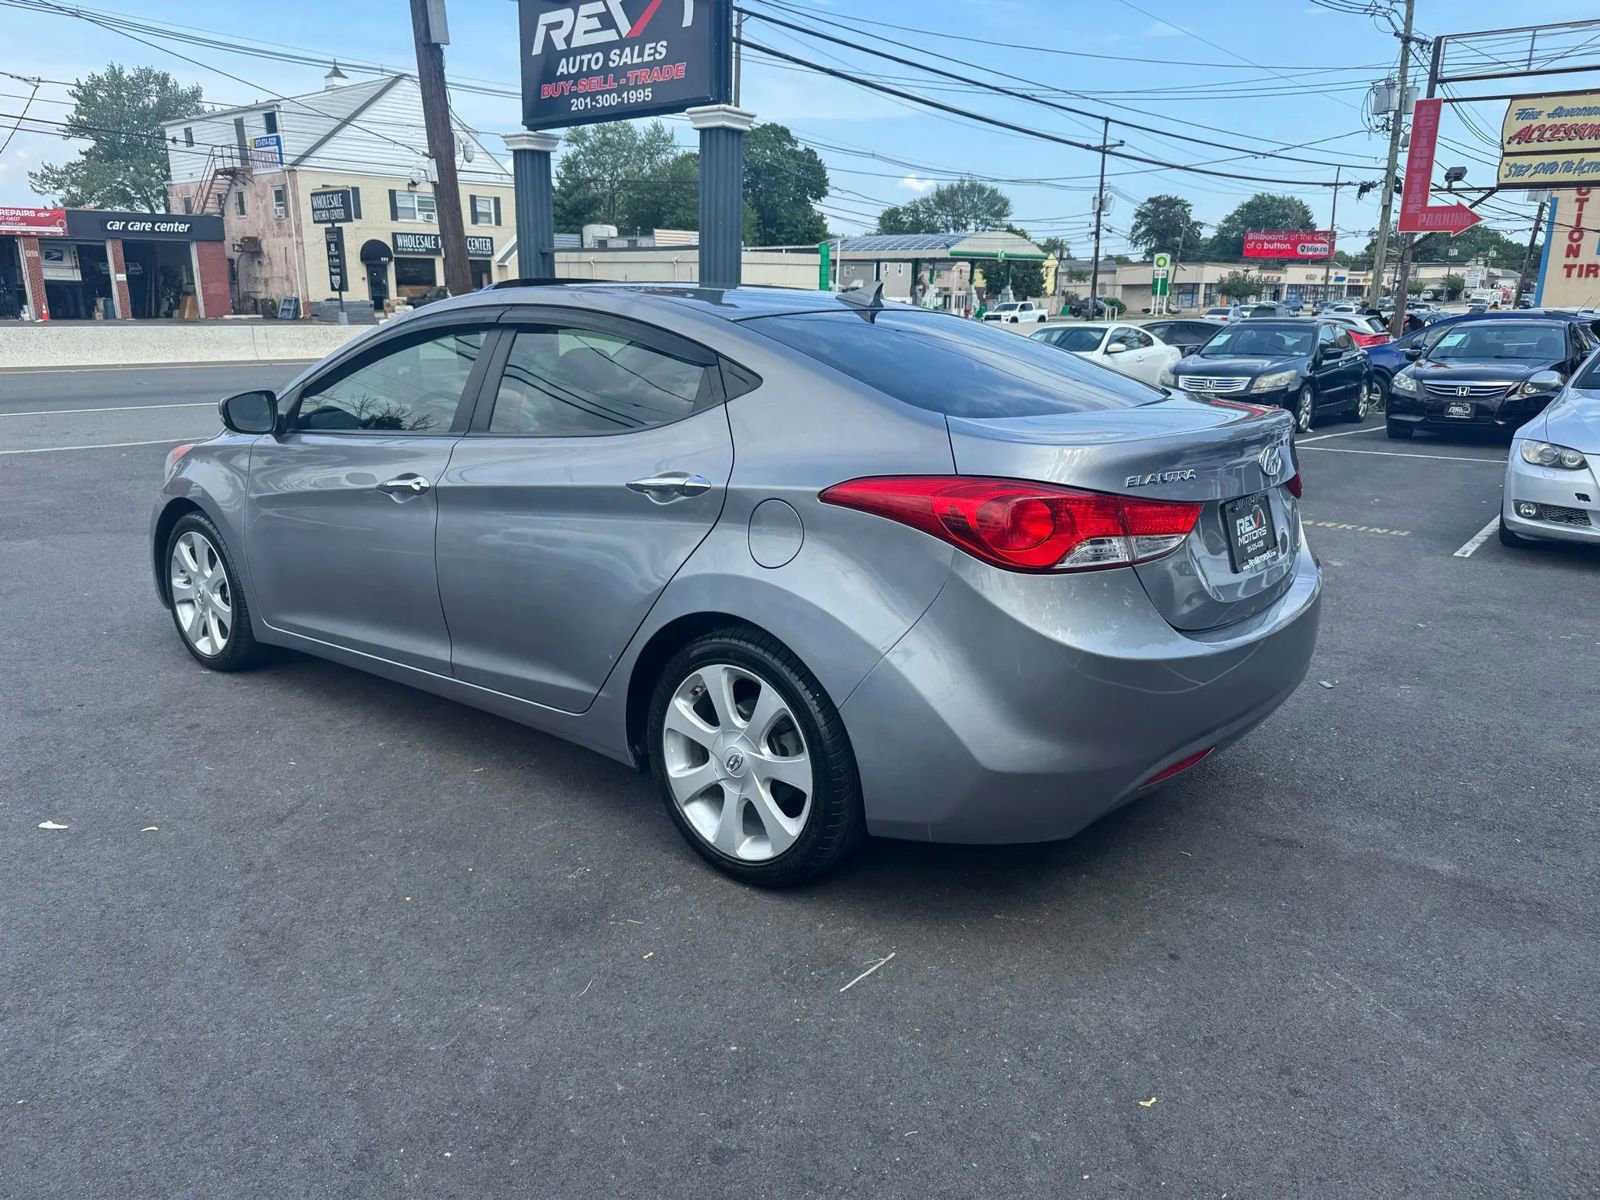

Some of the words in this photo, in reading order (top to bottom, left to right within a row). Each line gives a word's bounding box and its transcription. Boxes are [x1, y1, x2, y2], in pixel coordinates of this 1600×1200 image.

[556, 51, 604, 76] AUTO
[609, 40, 668, 68] SALES
[570, 88, 652, 111] 201-300-1995
[1413, 106, 1436, 168] ACTION
[312, 193, 343, 210] WHOLESALE
[1406, 173, 1425, 214] TIRE
[0, 209, 36, 217] REPAIRS
[313, 210, 329, 221] KITCHEN
[329, 208, 345, 220] CENTER
[1418, 211, 1473, 226] PARKING
[106, 220, 126, 231] car
[127, 221, 152, 232] care
[154, 221, 191, 233] center
[396, 233, 436, 249] WHOLESALE
[466, 236, 492, 251] CENTER
[1247, 232, 1288, 241] Billboards
[1263, 242, 1293, 250] button.
[1306, 244, 1328, 254] blip.co
[1125, 469, 1197, 488] ELANTRA
[1238, 526, 1267, 547] MOTORS
